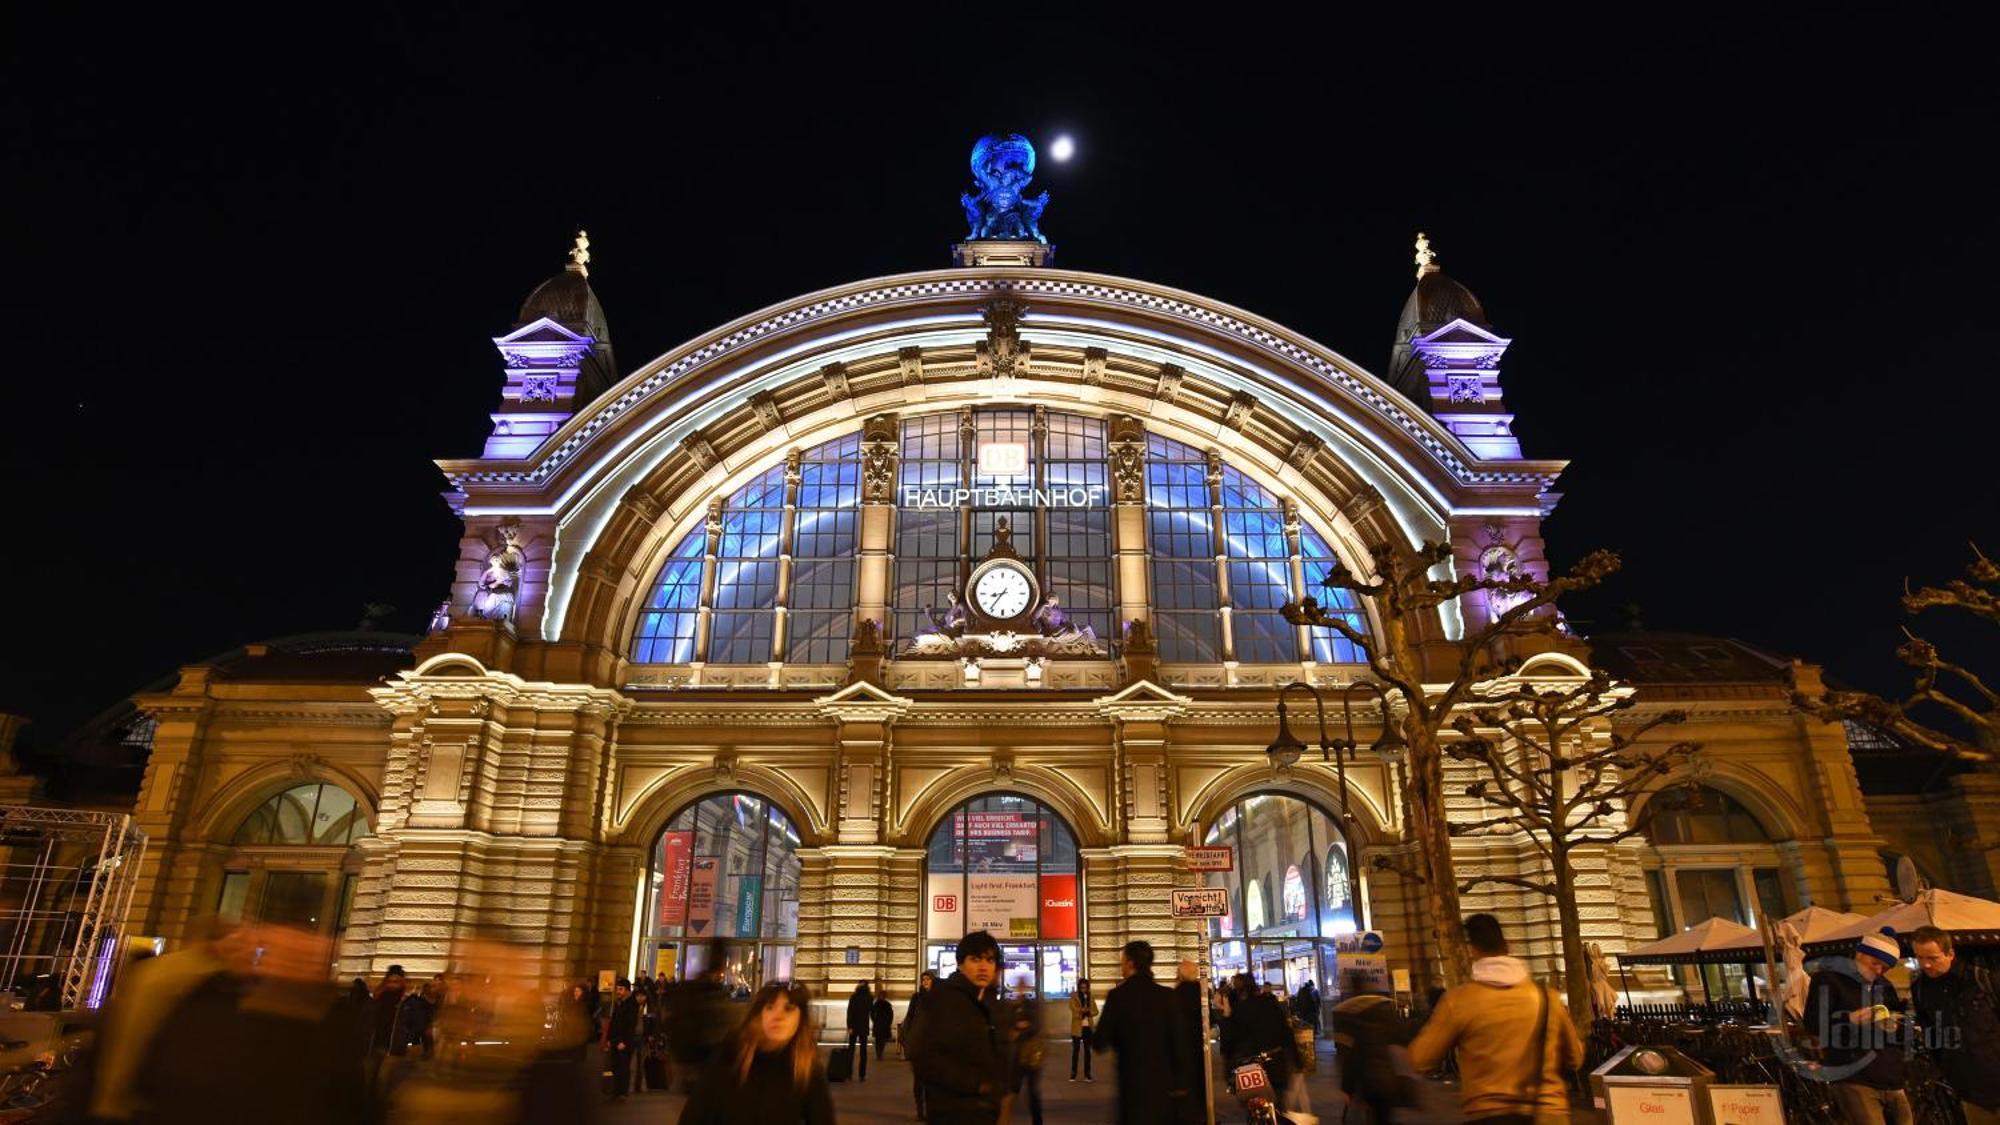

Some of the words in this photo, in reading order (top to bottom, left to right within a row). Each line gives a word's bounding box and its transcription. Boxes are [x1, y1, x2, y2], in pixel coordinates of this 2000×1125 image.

[985, 448, 1021, 469] DB
[905, 488, 1101, 508] HAUPTBAHNHOF
[936, 897, 954, 910] DB
[1240, 1072, 1263, 1089] DB
[1639, 1102, 1665, 1114] Glas
[1731, 1103, 1760, 1116] Papier
